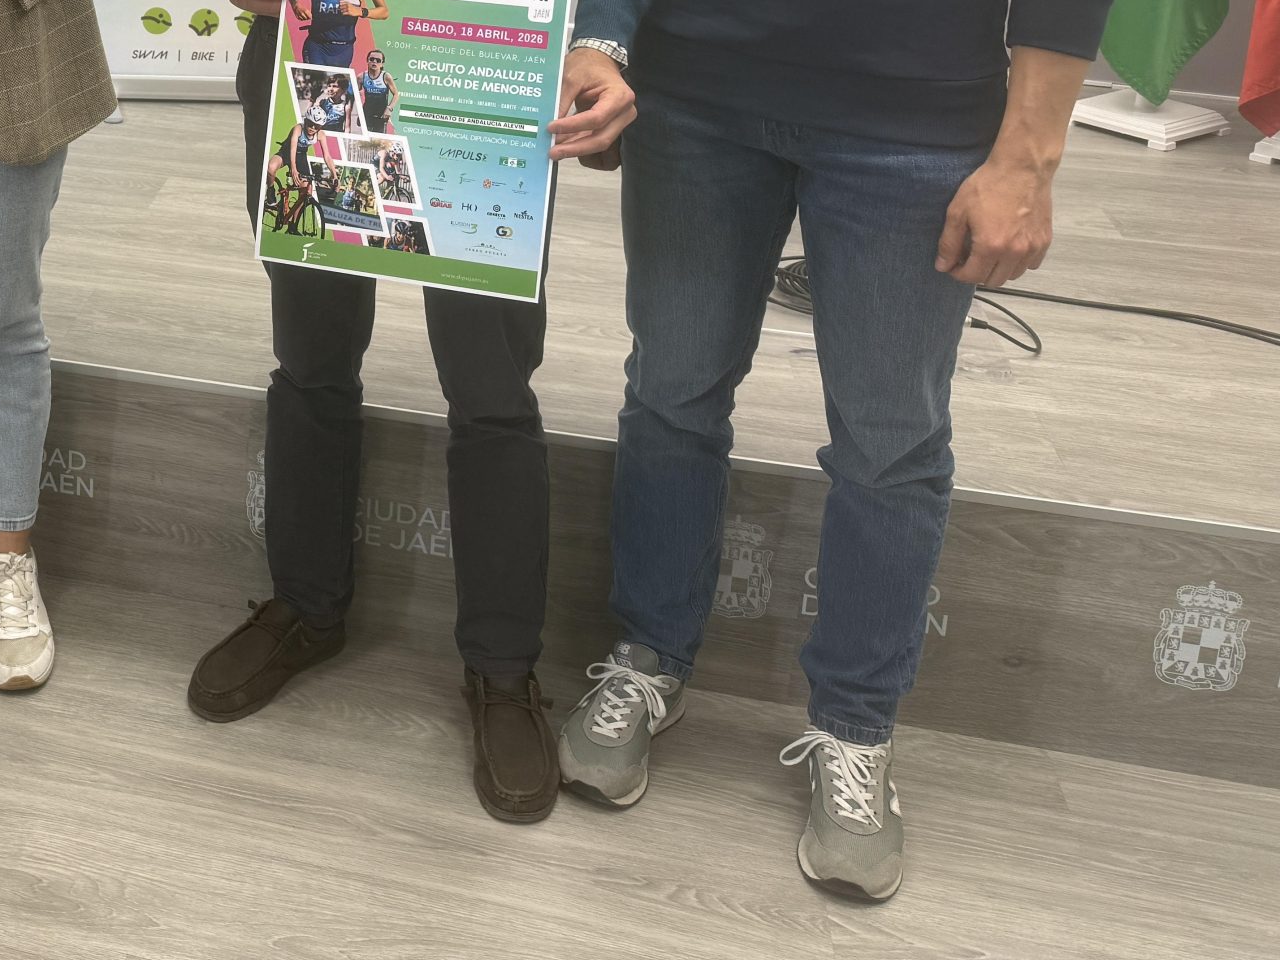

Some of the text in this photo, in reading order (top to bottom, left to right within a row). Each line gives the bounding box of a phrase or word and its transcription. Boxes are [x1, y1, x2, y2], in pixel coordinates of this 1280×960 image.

[407, 20, 544, 44] SÁBADO, 18 ABRIL, 2026
[132, 49, 215, 61] SWIM BIKE
[386, 40, 546, 64] 9.00H PARQUE DEL BULEVAR, JAÉN
[408, 59, 544, 83] CIRCUITO ANDALUZ DE
[405, 72, 542, 98] DUATLÓN DE MENORES
[414, 112, 457, 122] CAMPEONATO
[403, 126, 432, 136] CIRCUITO
[433, 129, 469, 141] PROVINCIAL
[470, 134, 508, 145] DIPUTACIÓN
[40, 469, 94, 498] AÉN
[389, 528, 453, 559] JAÉ
